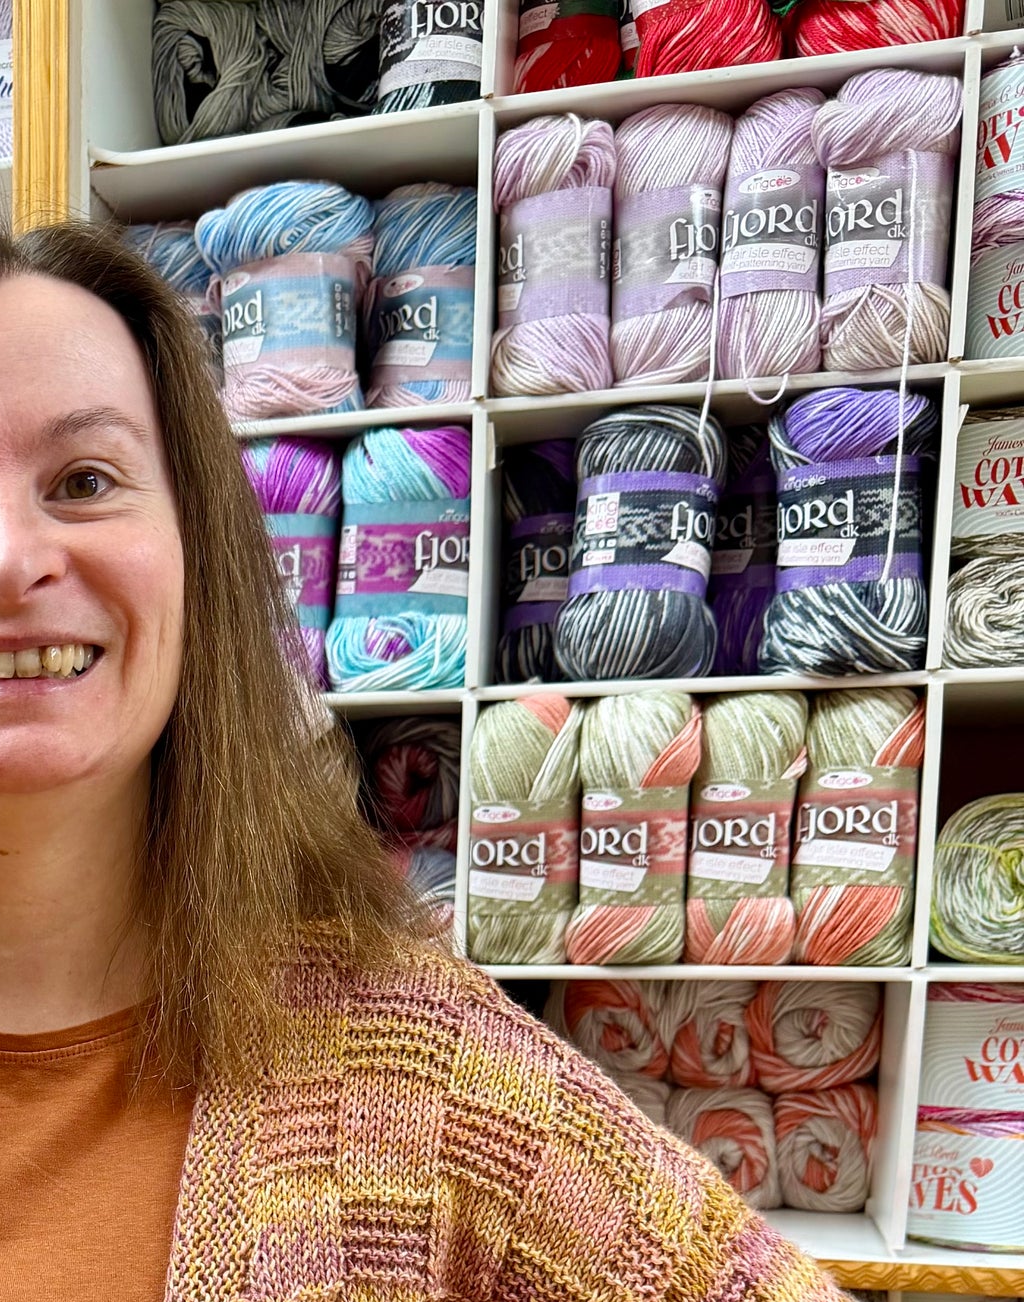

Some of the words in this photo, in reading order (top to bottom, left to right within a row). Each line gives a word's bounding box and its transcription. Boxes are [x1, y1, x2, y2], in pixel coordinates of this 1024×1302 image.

[887, 224, 906, 239] dk
[748, 245, 769, 258] isle
[772, 247, 807, 262] effect
[853, 243, 890, 257] effect
[422, 327, 440, 341] dk
[974, 455, 1024, 487] COT
[840, 524, 860, 539] dk
[810, 542, 844, 554] effect
[882, 833, 900, 847] dk
[760, 846, 777, 858] dk
[632, 853, 651, 867] dk
[729, 858, 762, 871] effect
[531, 863, 549, 877] dk
[501, 878, 534, 891] effect
[909, 1176, 978, 1216] VES
